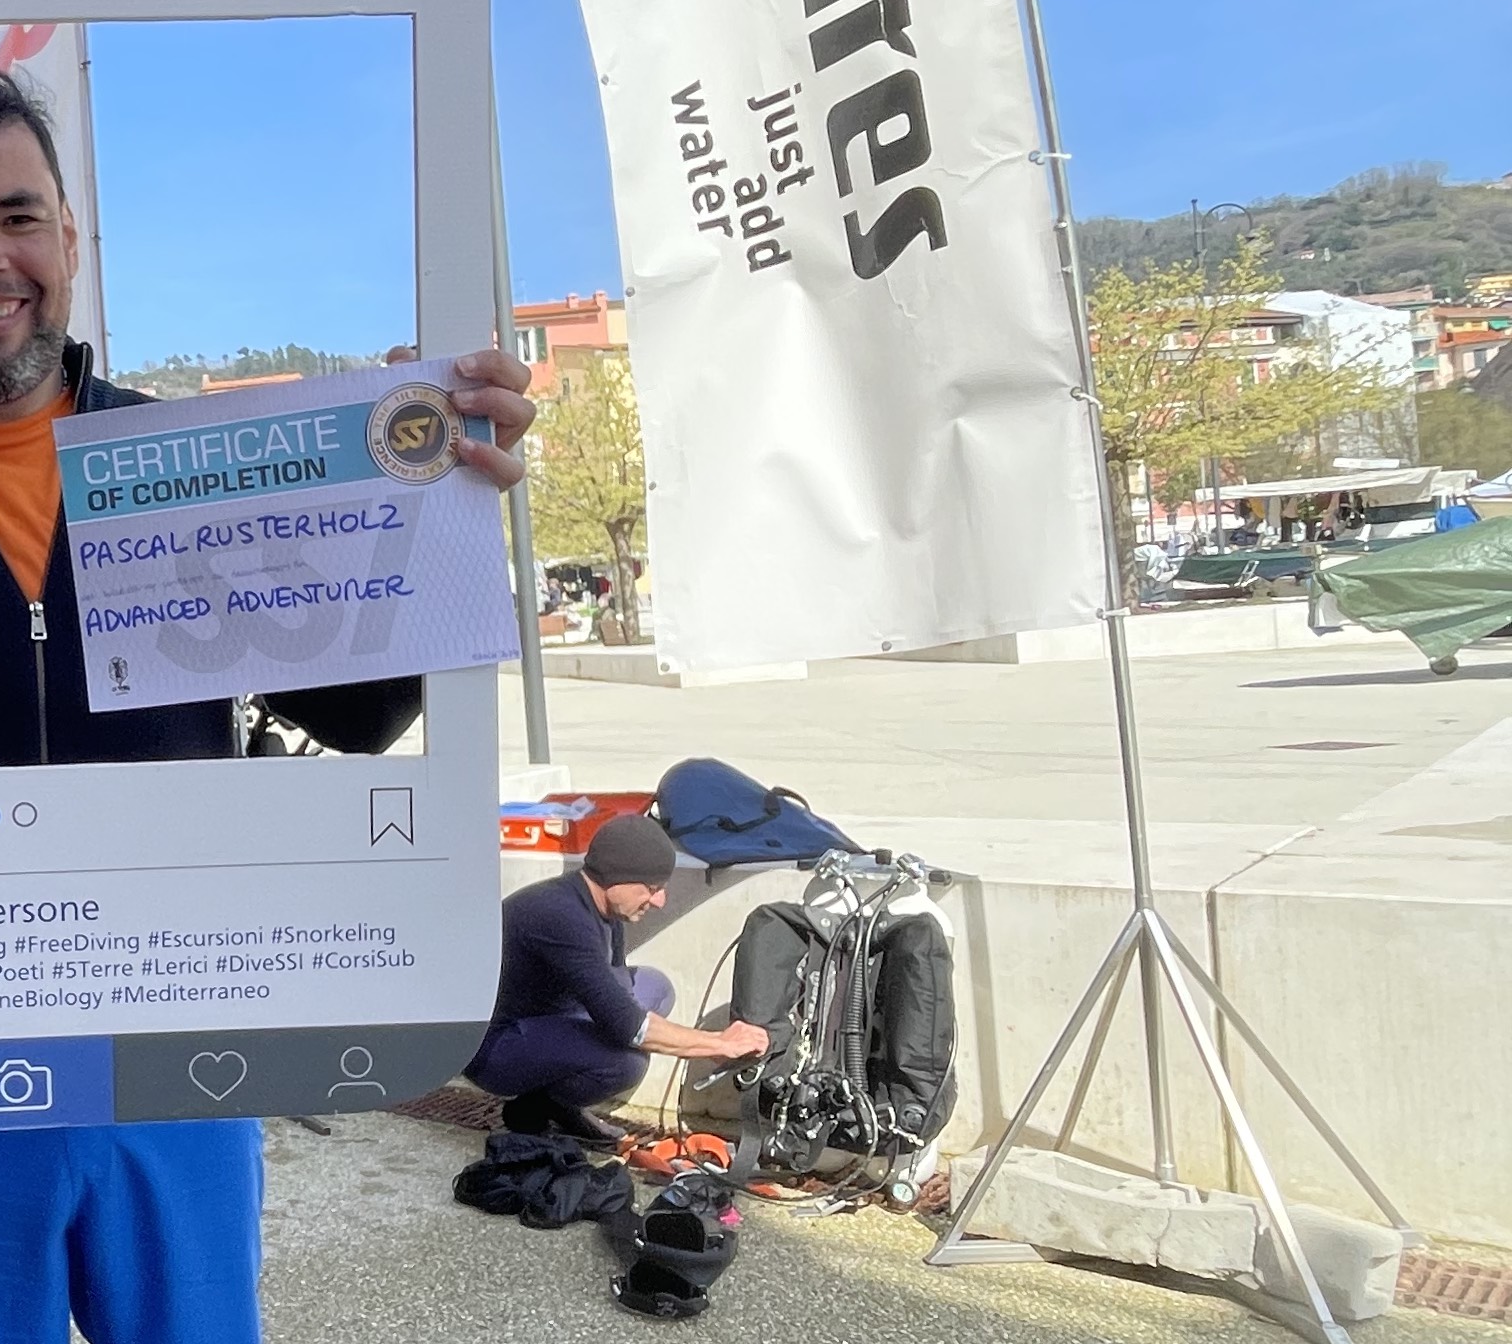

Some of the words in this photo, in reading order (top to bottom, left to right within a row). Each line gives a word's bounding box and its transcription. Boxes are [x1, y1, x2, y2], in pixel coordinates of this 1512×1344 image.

[670, 79, 734, 239] water
[747, 82, 815, 195] just
[733, 172, 792, 273] add
[82, 414, 340, 486] CERTIFICATE
[88, 486, 124, 512] OF
[132, 457, 328, 505] COMPLETION
[80, 530, 188, 570] PASCAL
[196, 504, 404, 553] RUSTERHOLZ
[85, 597, 211, 637] ADVANCED
[226, 575, 414, 616] ADVENTURER
[14, 932, 140, 955] #FreeDiving
[148, 926, 264, 950] #Escursioni
[271, 923, 396, 946] #Snorkeling
[52, 959, 134, 980] #5Terre
[141, 955, 209, 977] #Lerici
[215, 952, 304, 974] #DiveSSI
[312, 949, 416, 971] #CorsiSub
[110, 983, 271, 1005] #Mediterraneo
